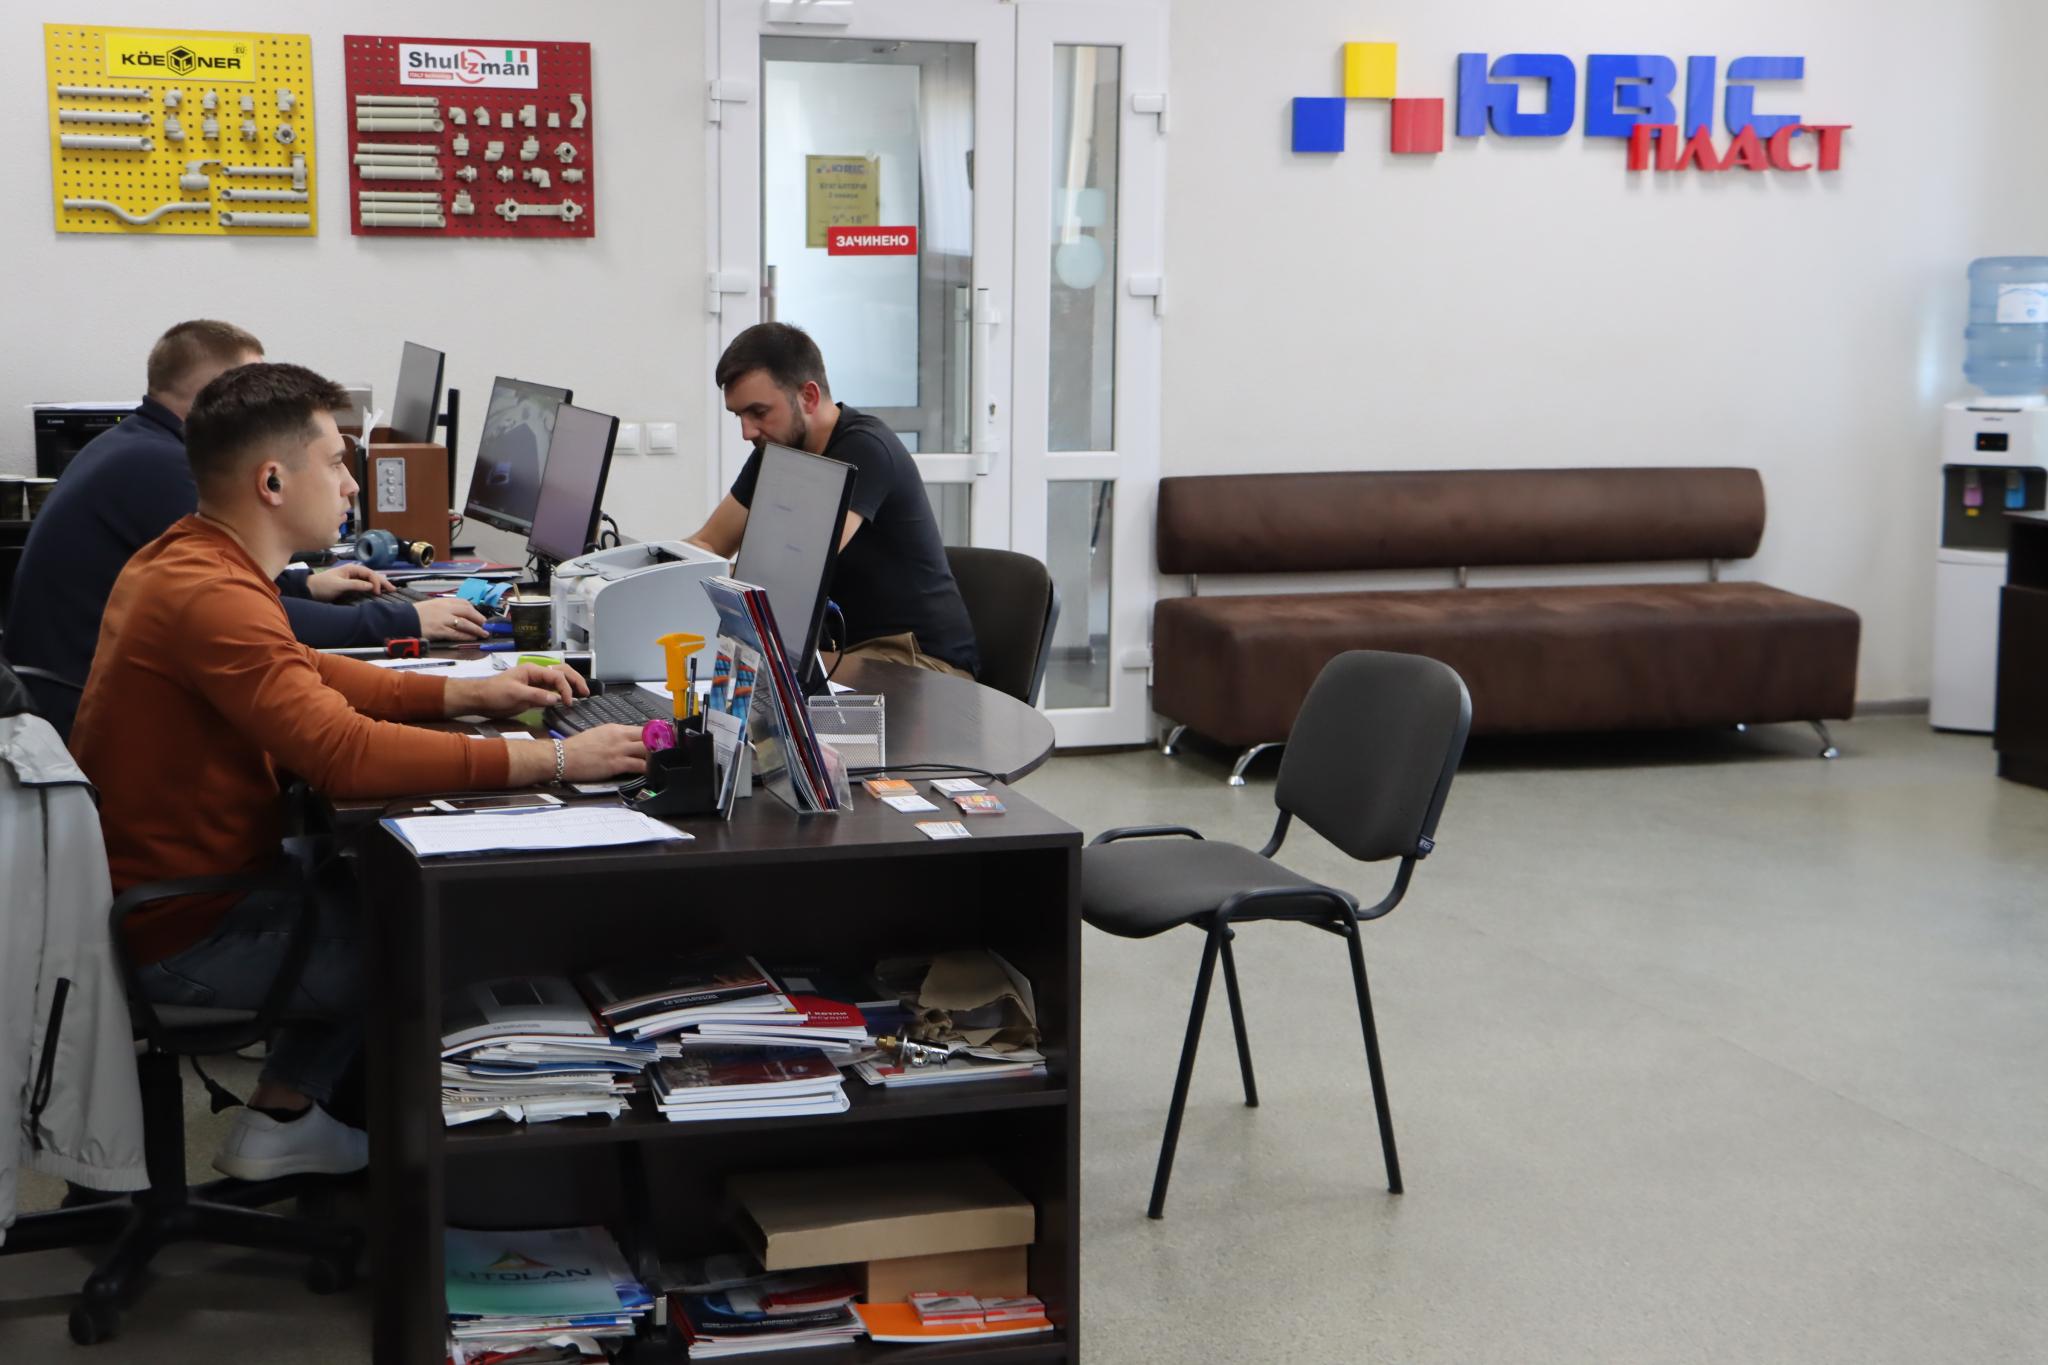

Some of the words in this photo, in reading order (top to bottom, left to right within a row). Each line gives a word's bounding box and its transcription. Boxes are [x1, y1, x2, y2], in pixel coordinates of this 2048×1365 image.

[408, 50, 529, 76] Shultzman
[1456, 53, 1804, 137] ЮВІС
[1626, 124, 1852, 171] ПЛАСТ
[836, 235, 909, 247] ЗАЧИНЕНО
